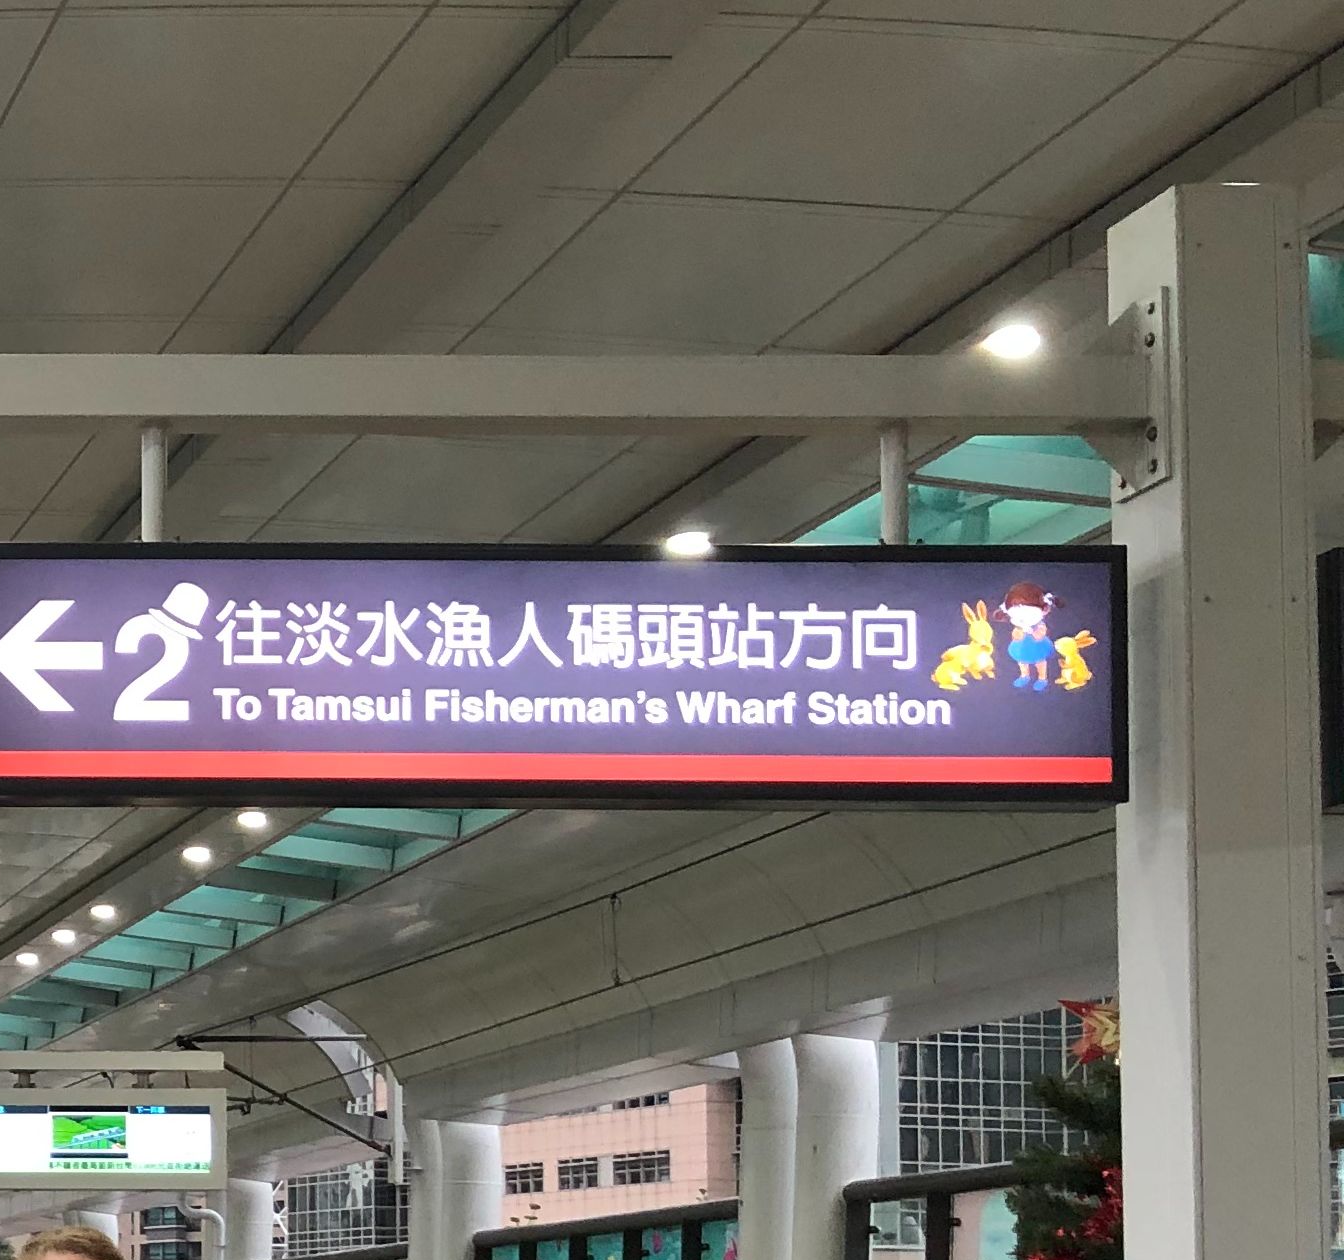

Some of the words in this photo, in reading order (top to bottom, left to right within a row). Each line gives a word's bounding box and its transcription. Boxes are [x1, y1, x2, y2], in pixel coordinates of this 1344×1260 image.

[113, 613, 192, 722] 2
[215, 599, 919, 670] 往淡水漁人碼頭站方向
[213, 687, 263, 722] To
[268, 687, 412, 722] Tamsui
[425, 688, 669, 725] Fisherman's
[675, 690, 798, 725] Wharf
[808, 691, 952, 726] Station
